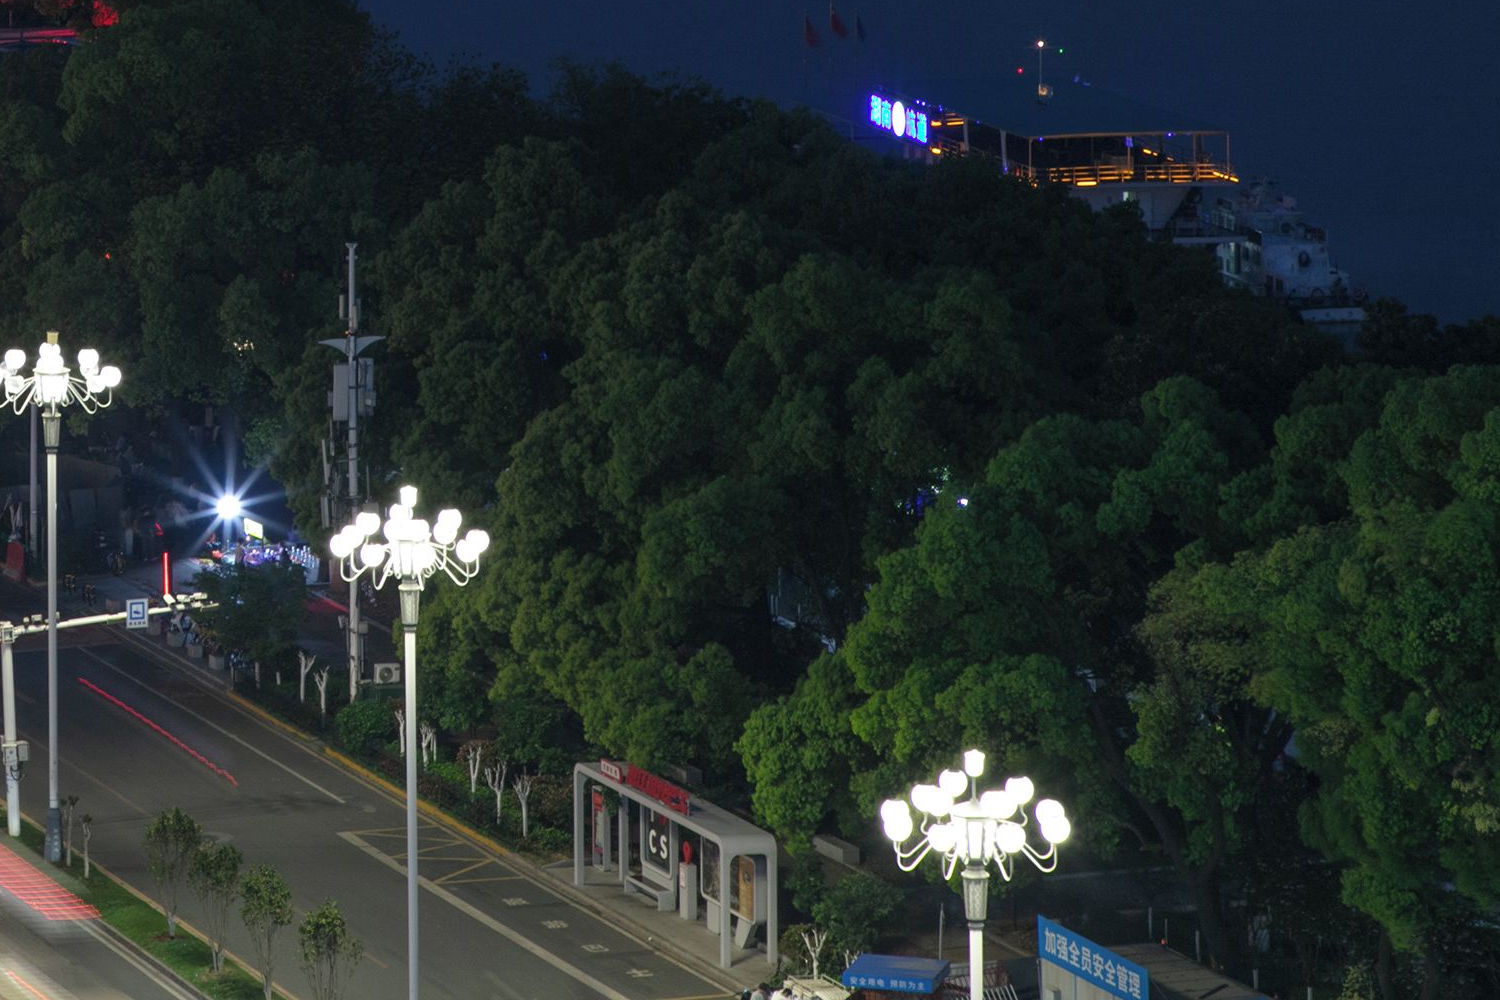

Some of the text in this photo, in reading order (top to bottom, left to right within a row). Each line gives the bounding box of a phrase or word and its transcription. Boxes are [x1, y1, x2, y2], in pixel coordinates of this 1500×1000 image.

[648, 828, 668, 860] CS
[1044, 926, 1141, 1000] 加强全员安全管理
[889, 979, 925, 991] 预防为主
